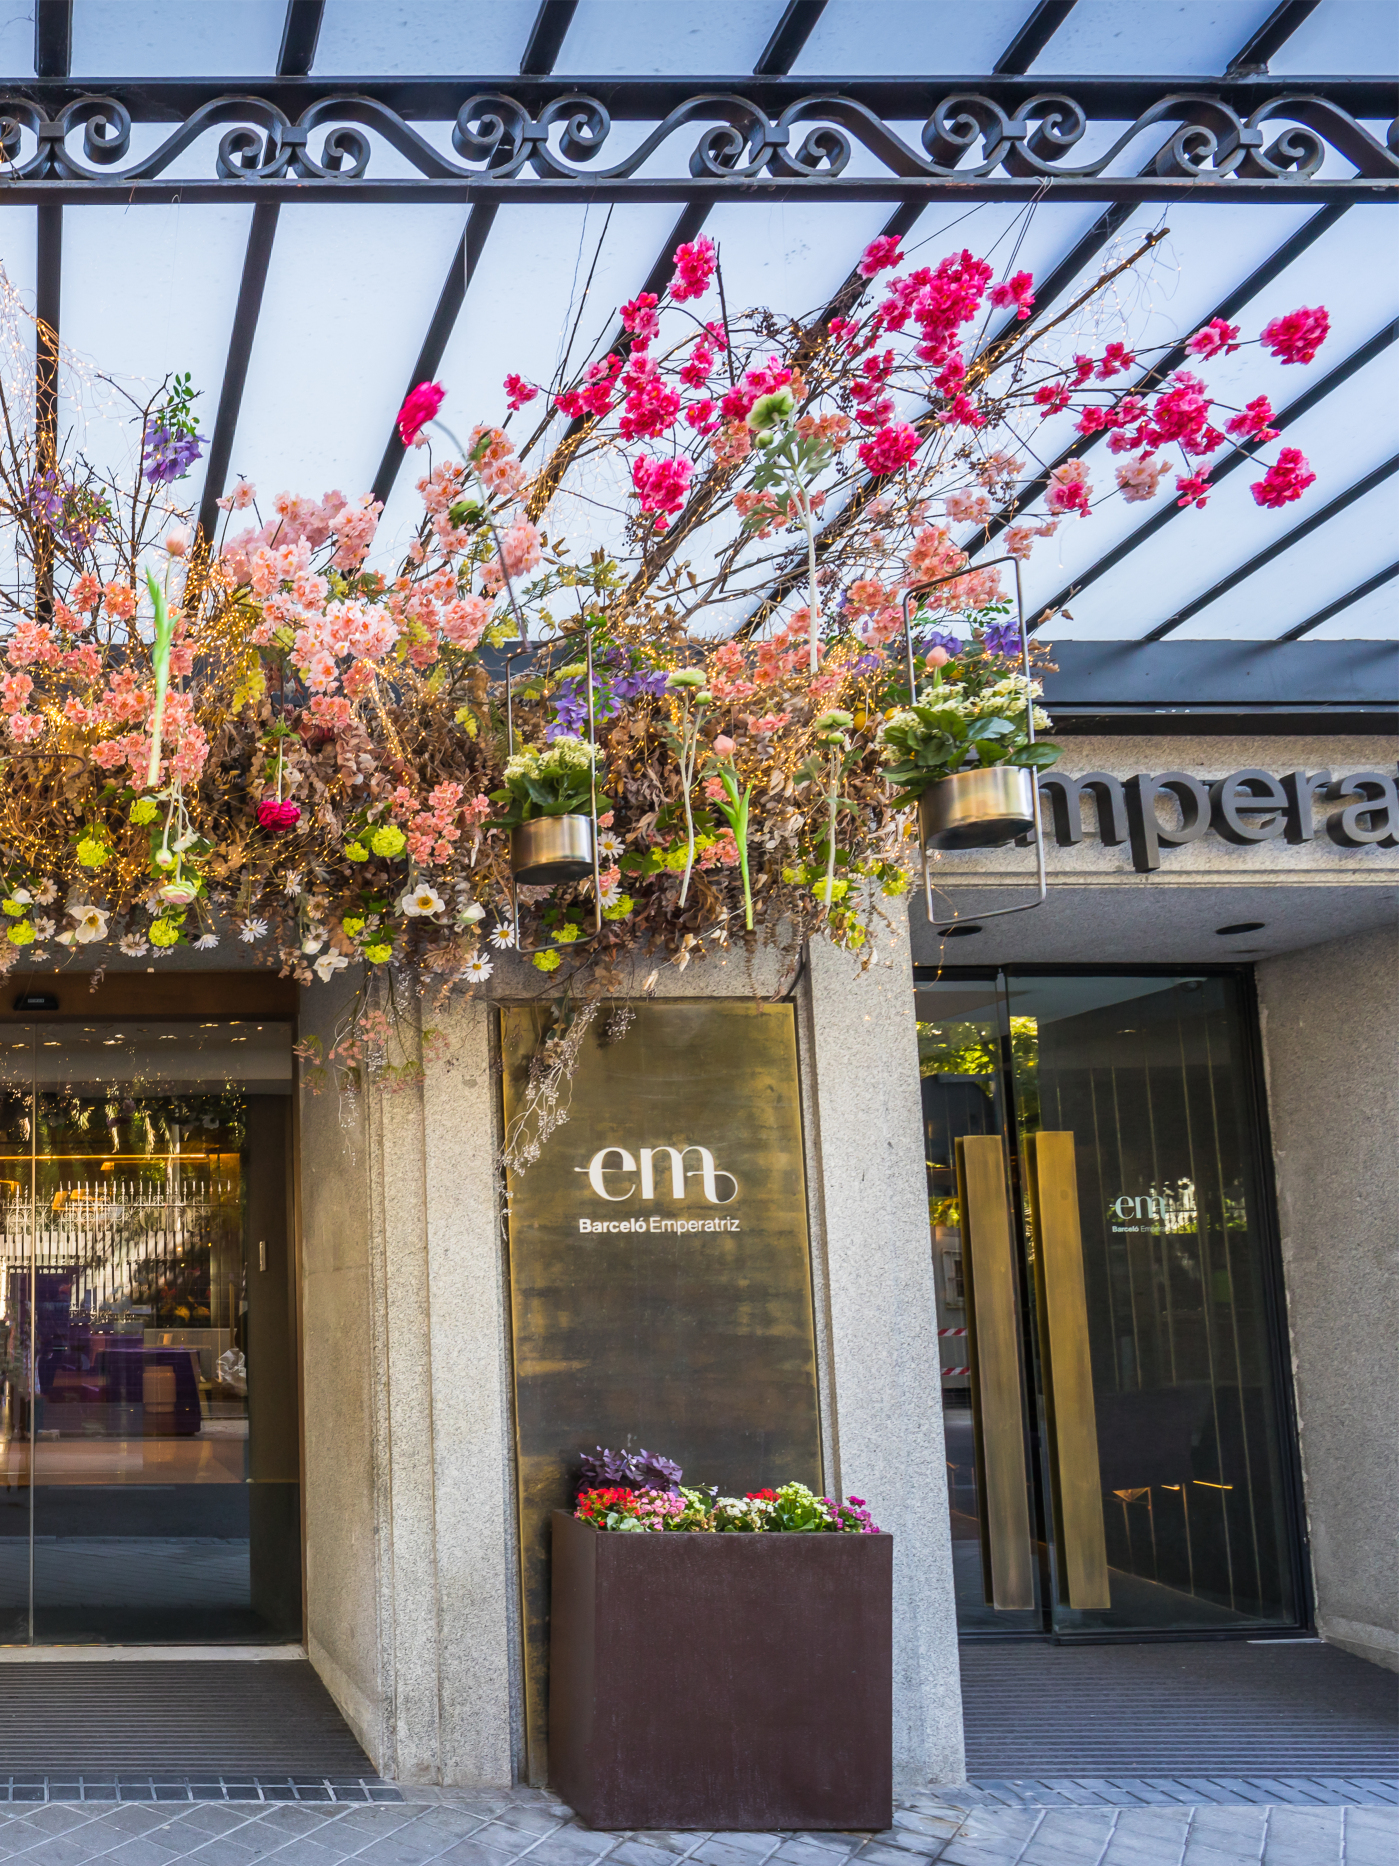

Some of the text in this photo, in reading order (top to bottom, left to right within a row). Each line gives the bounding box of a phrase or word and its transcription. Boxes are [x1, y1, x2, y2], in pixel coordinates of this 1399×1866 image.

[962, 750, 1399, 873] mpera
[574, 1145, 738, 1203] em
[579, 1216, 741, 1235] Barceló Emperatriz
[1111, 1225, 1140, 1233] Barceló
